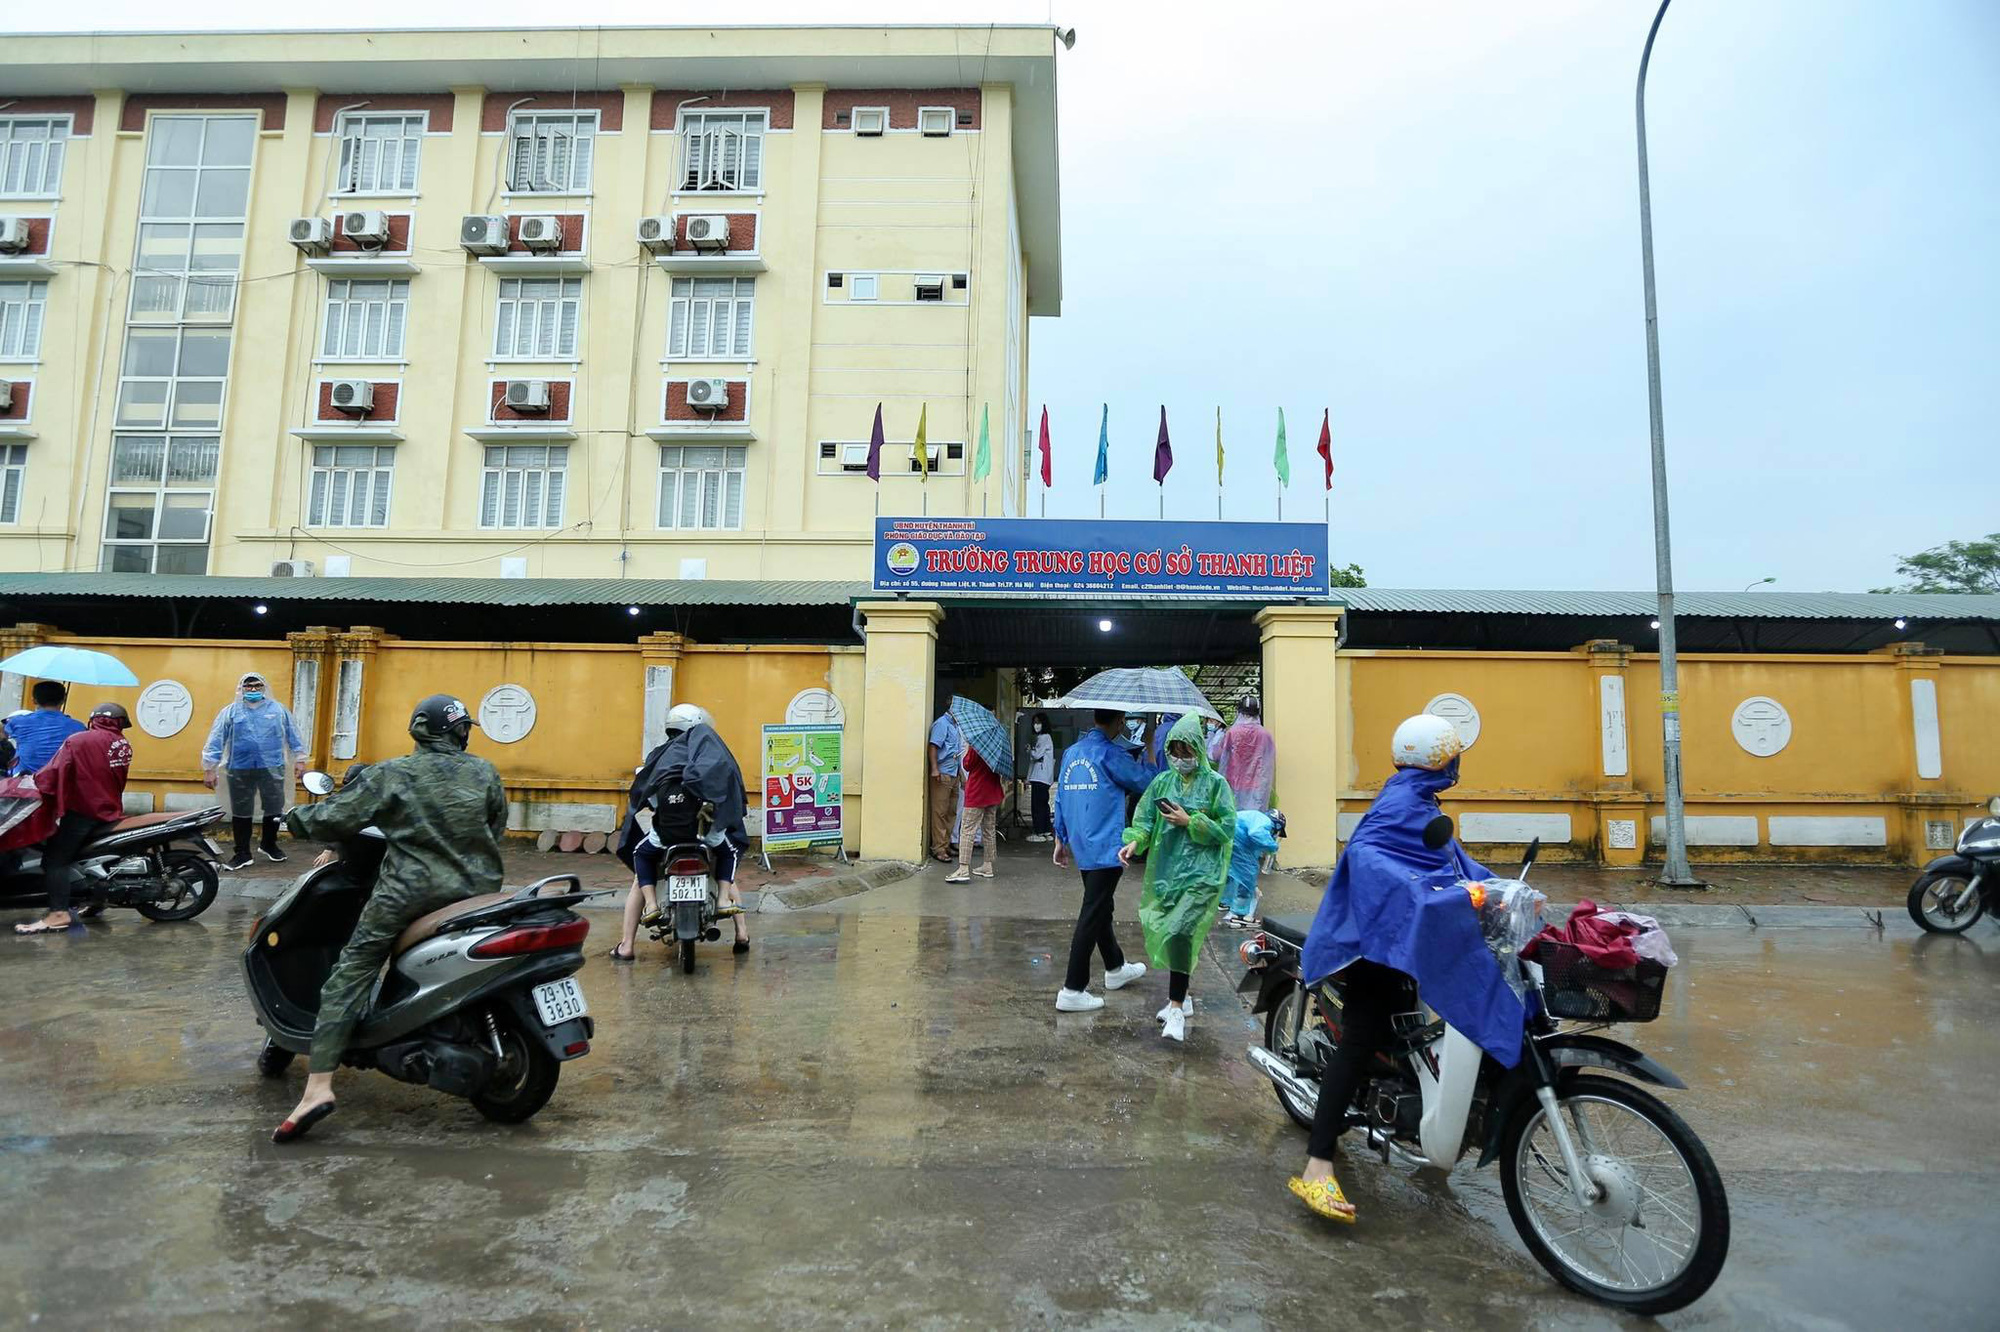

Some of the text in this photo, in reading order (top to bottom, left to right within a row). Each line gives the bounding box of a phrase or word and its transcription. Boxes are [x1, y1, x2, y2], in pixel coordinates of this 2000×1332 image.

[914, 520, 938, 531] HUYỆN
[938, 521, 963, 530] THANH
[884, 531, 986, 541] PHÒNG GIÁO DỤC VÀ ĐÀO TẠO
[925, 544, 1009, 573] TRƯỜNG
[1014, 551, 1084, 573] TRUNG
[1088, 551, 1130, 581] HỌC
[1134, 548, 1162, 575] CƠ
[1165, 544, 1193, 575] SỞ
[1197, 553, 1267, 576] THANH
[1271, 548, 1316, 582] LIỆT
[797, 776, 812, 786] 5K
[672, 888, 703, 900] 502.11
[547, 998, 581, 1021] 3830
